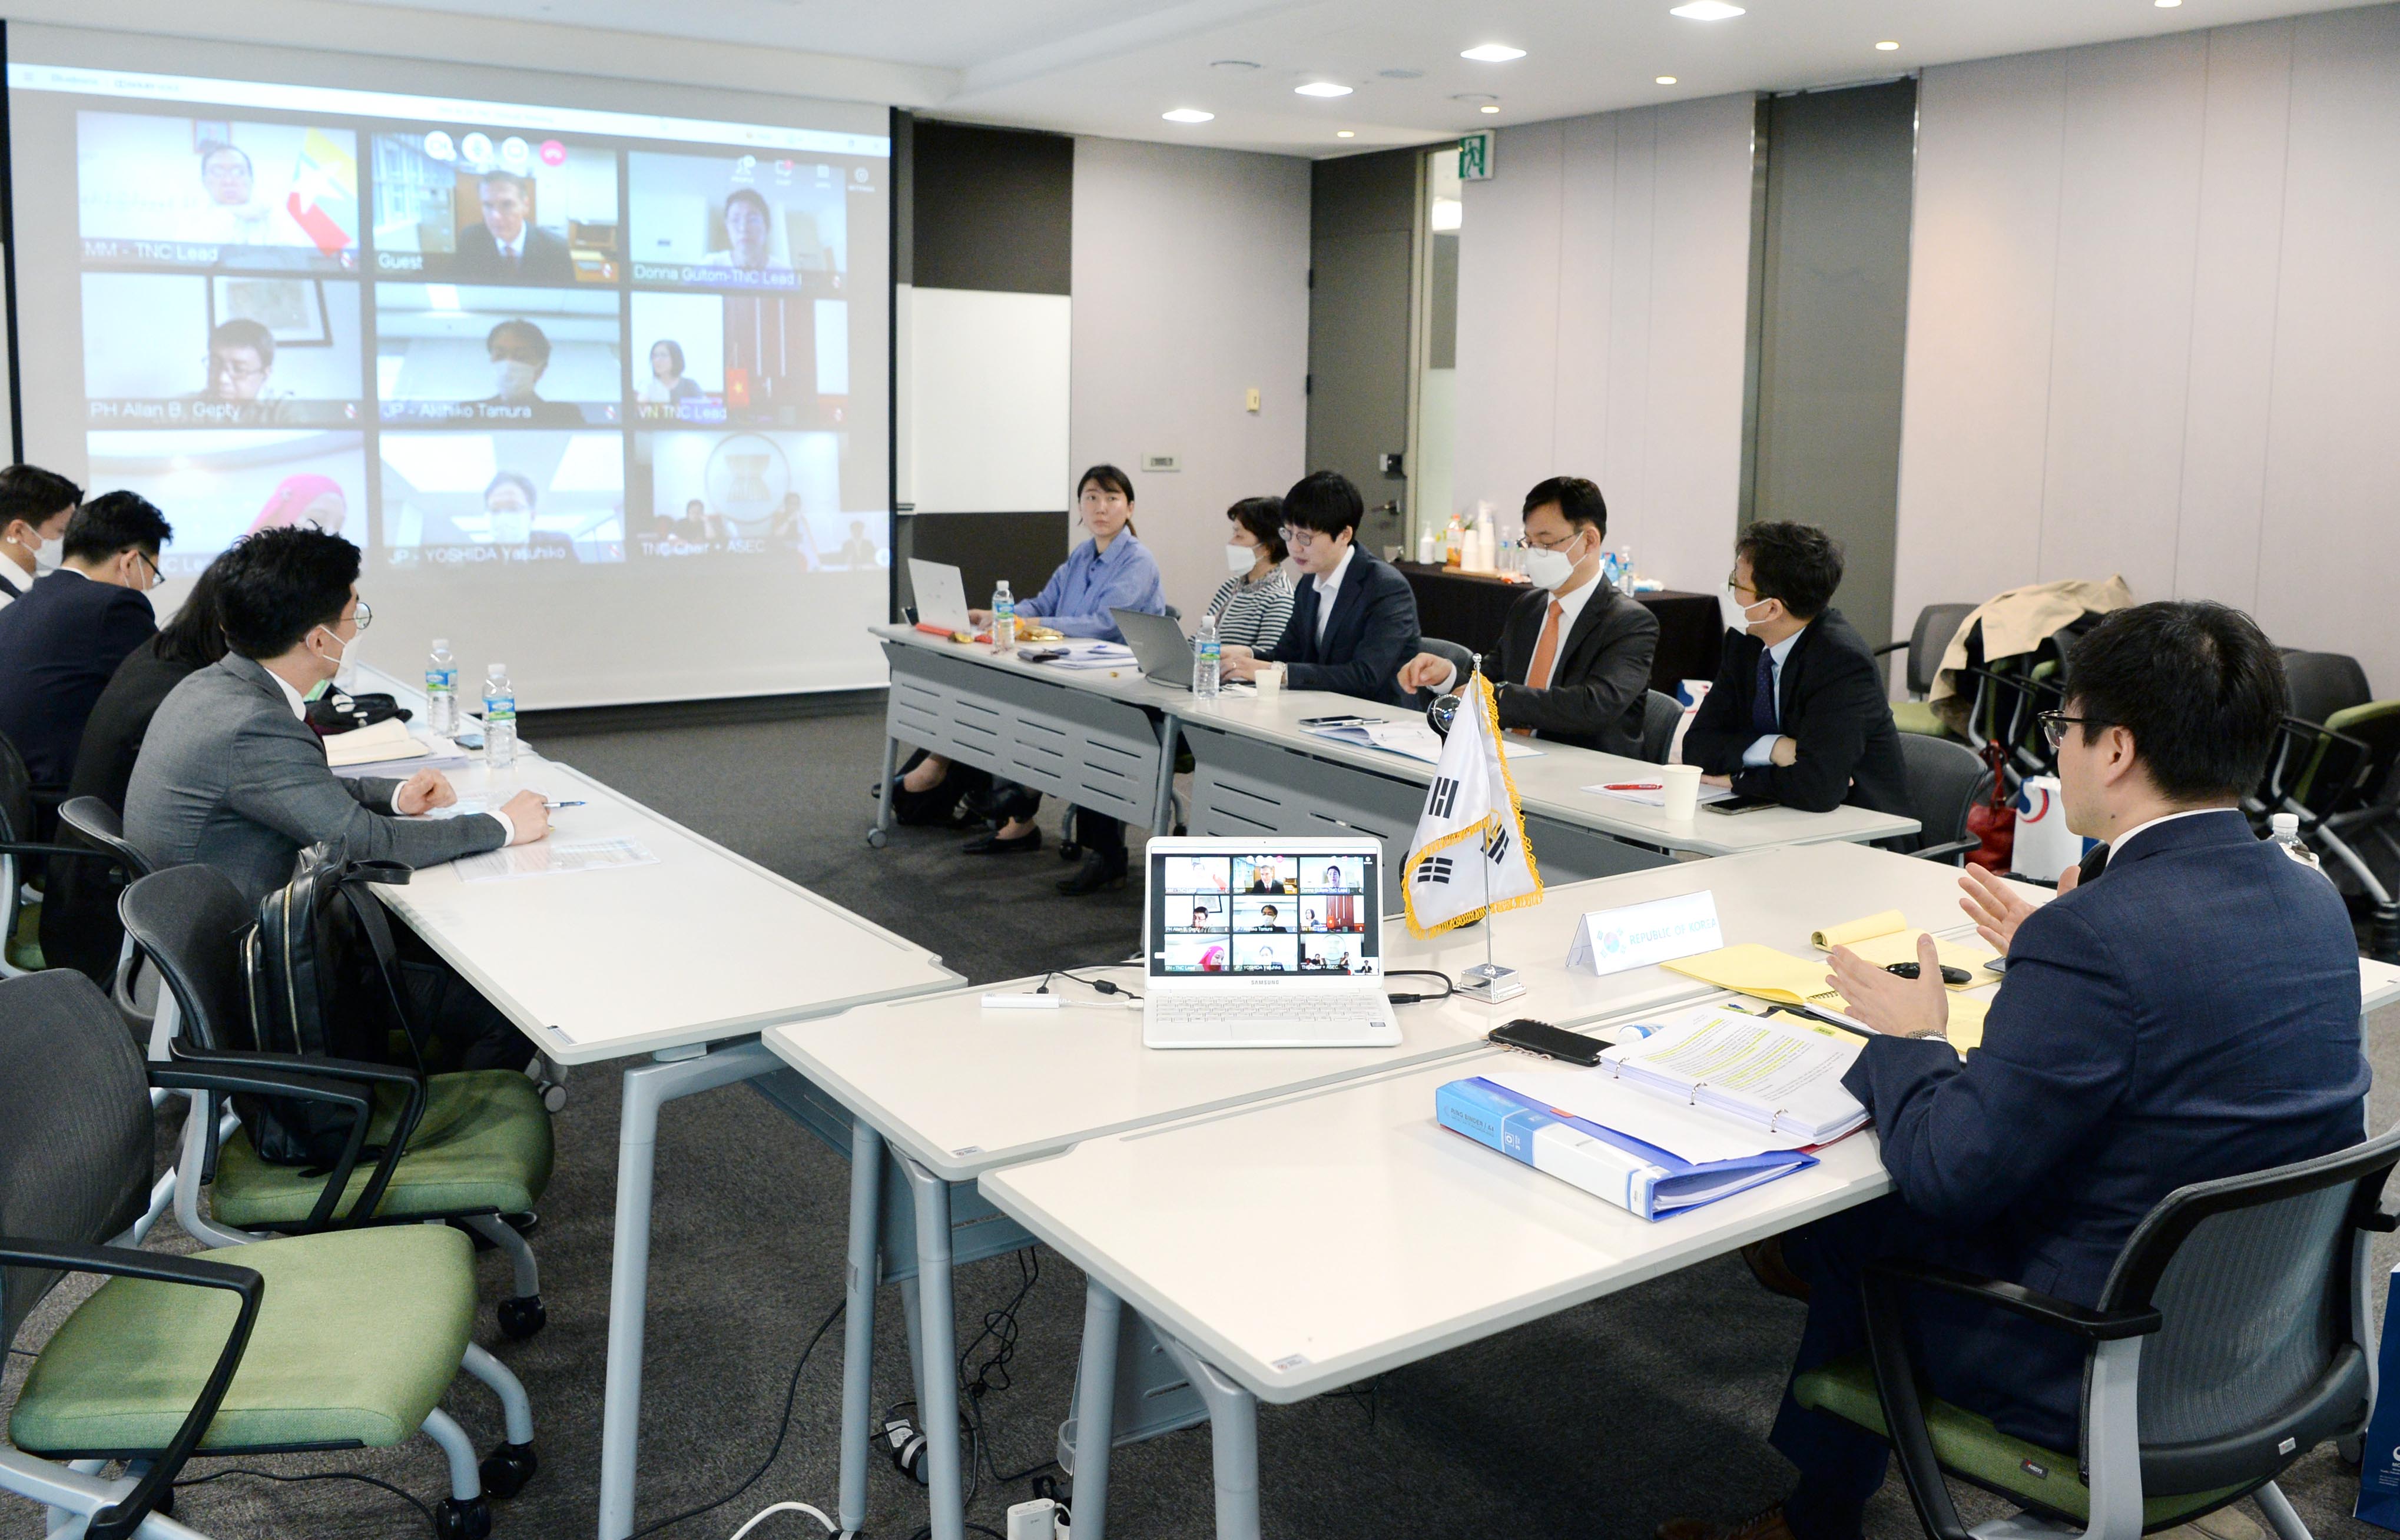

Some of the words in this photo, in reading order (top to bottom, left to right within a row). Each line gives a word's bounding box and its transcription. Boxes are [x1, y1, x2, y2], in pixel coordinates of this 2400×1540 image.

[84, 240, 117, 257] MM
[136, 241, 173, 260] TNC
[177, 244, 218, 262] Lead
[378, 251, 423, 270] Guest
[635, 263, 677, 280] Donna
[763, 271, 795, 286] Lead
[90, 401, 118, 418] PH
[122, 401, 163, 418] Allan
[193, 401, 240, 422] Gepty
[383, 401, 405, 419] JP
[478, 403, 532, 419] Tamura
[638, 405, 658, 419] VN
[663, 405, 691, 420] TNC
[695, 406, 728, 420] Lead
[389, 548, 409, 564] JP
[426, 547, 497, 563] YOSHIDA
[1629, 927, 1672, 945] REPUBLIC
[1675, 924, 1686, 935] OF
[1689, 918, 1716, 932] KOREA
[1450, 1108, 1463, 1117] RING
[1464, 1114, 1483, 1127] BINDER
